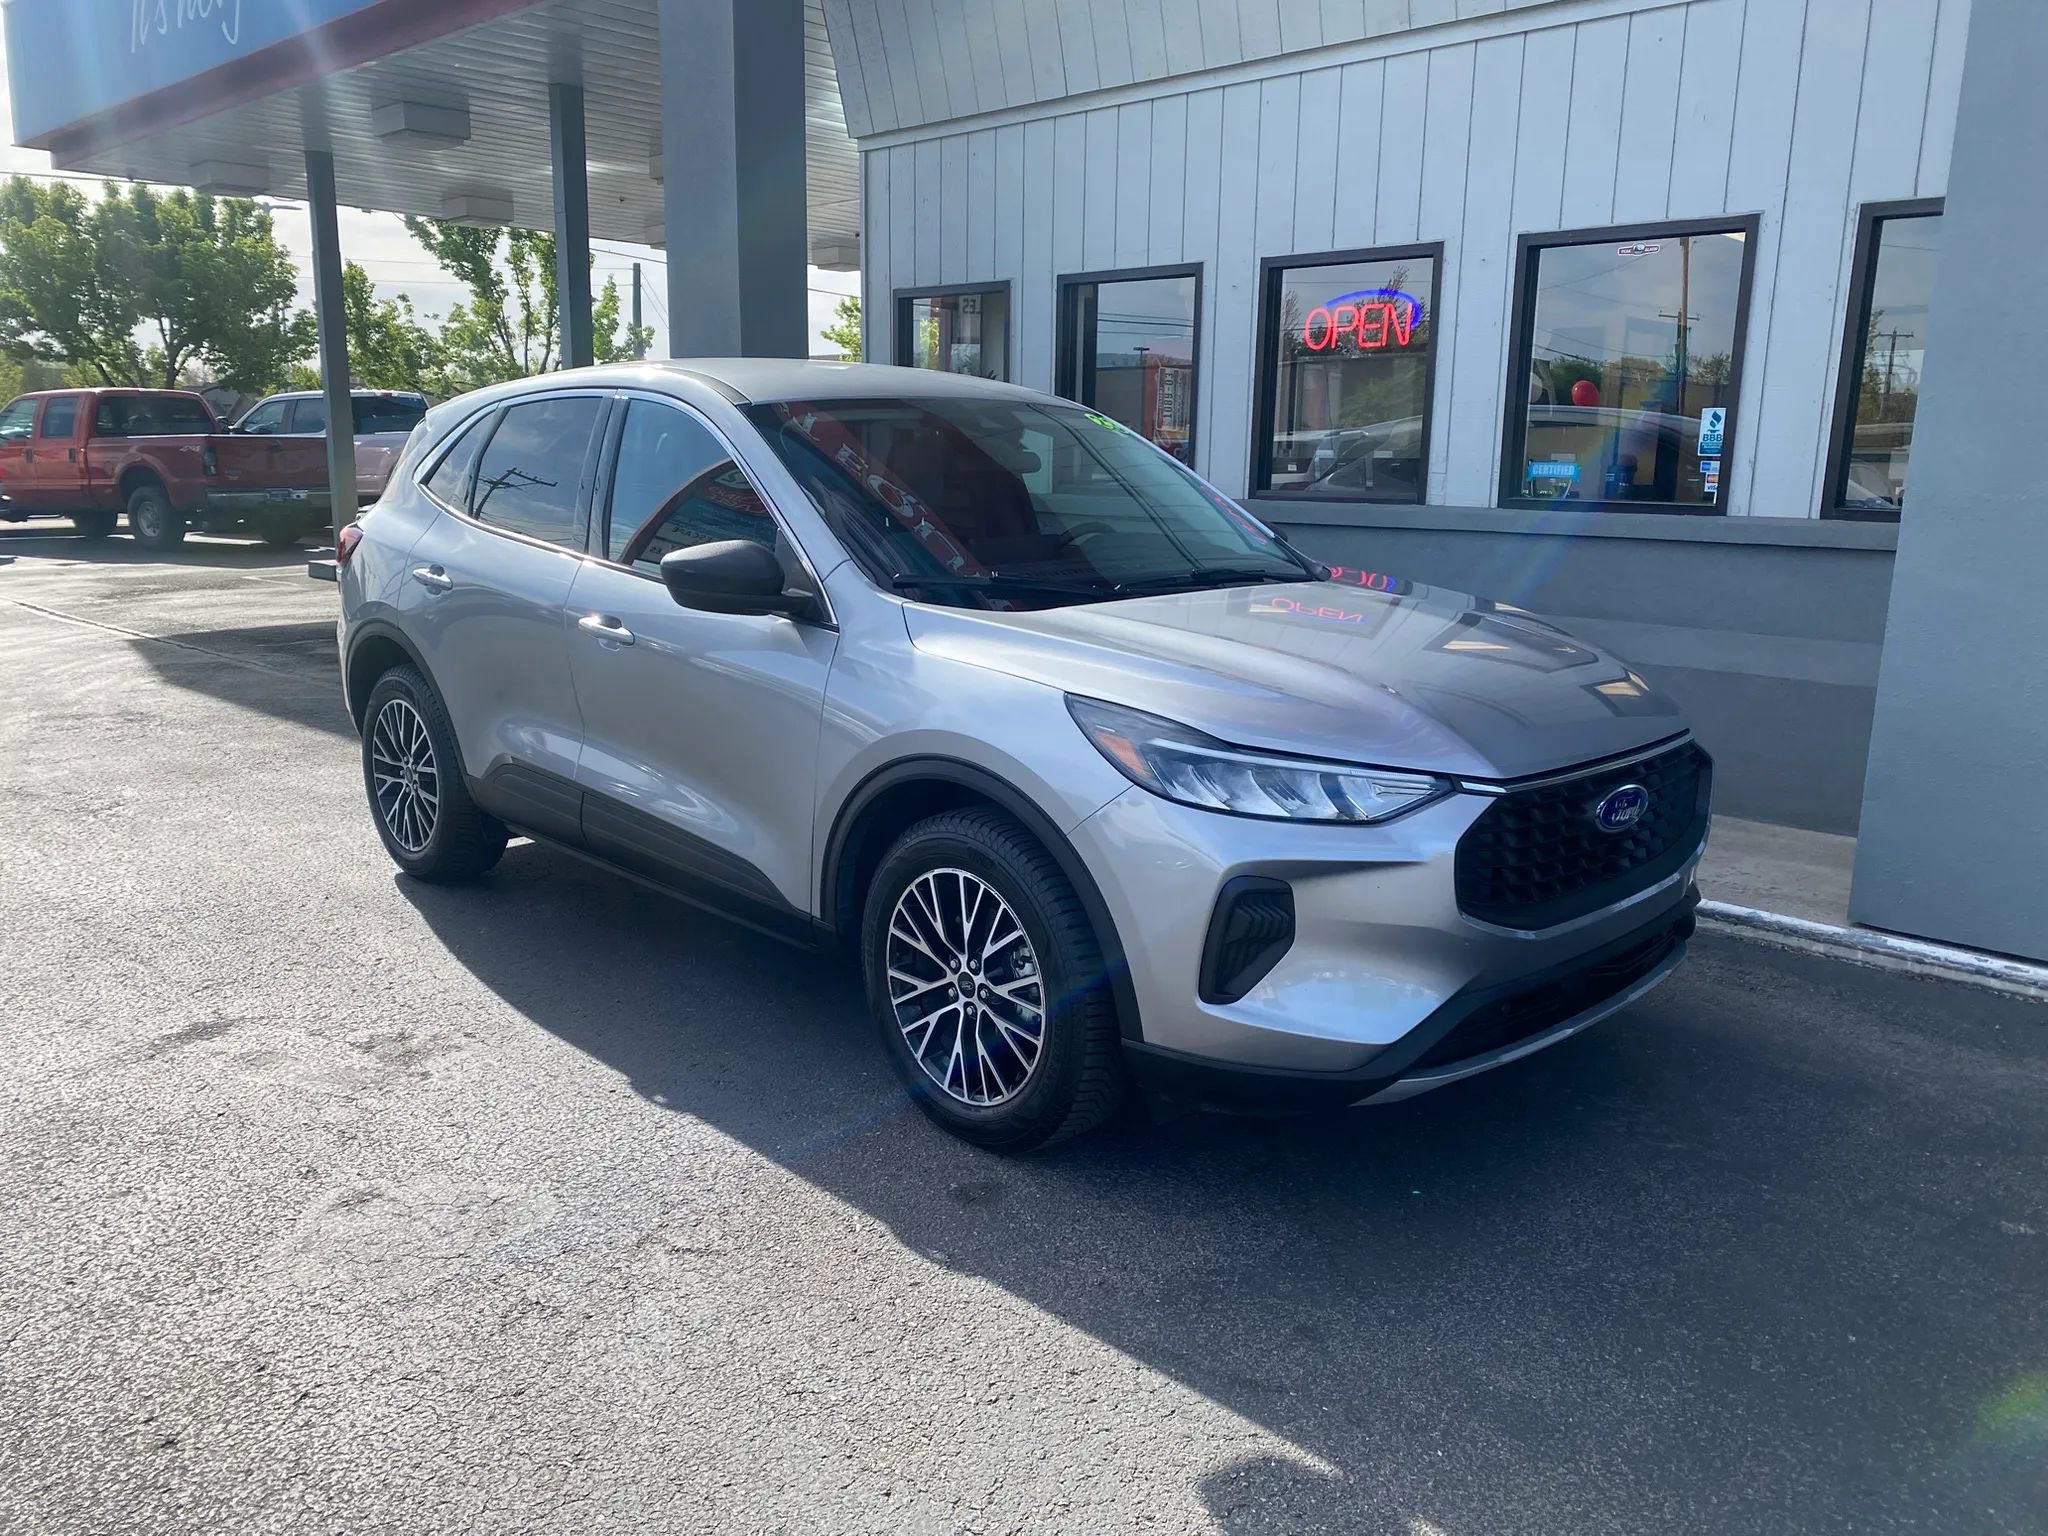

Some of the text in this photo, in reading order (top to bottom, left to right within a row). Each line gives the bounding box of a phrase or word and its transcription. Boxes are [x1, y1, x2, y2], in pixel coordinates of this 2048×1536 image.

[1304, 302, 1413, 350] OPEN
[1702, 433, 1722, 442] BBB
[1532, 464, 1575, 475] CERTIFIED
[1610, 797, 1641, 823] Ford
